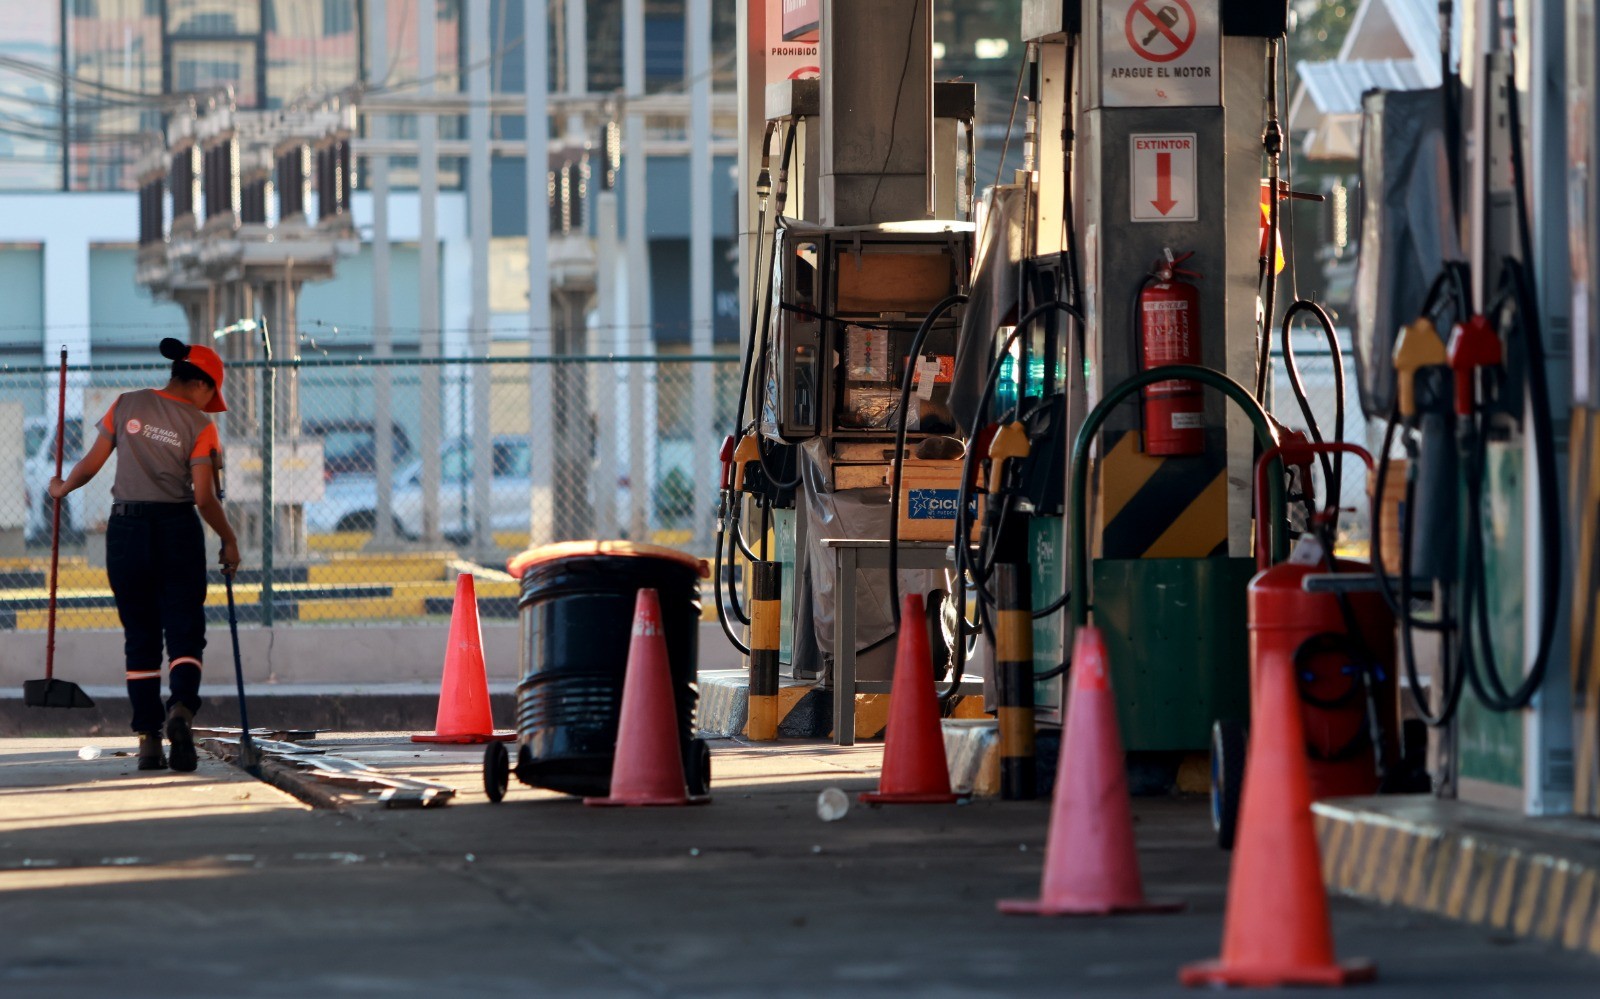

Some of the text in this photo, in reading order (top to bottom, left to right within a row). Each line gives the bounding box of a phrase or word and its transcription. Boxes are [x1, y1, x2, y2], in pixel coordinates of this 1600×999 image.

[771, 47, 817, 56] PROHIBIDO
[1111, 66, 1212, 78] APAGUE EL MOTOR
[1136, 140, 1191, 150] EXTINTOR
[144, 424, 160, 433] QUE
[160, 428, 178, 438] NADA
[143, 430, 182, 448] TE DETENGA
[929, 499, 977, 510] CICLN
